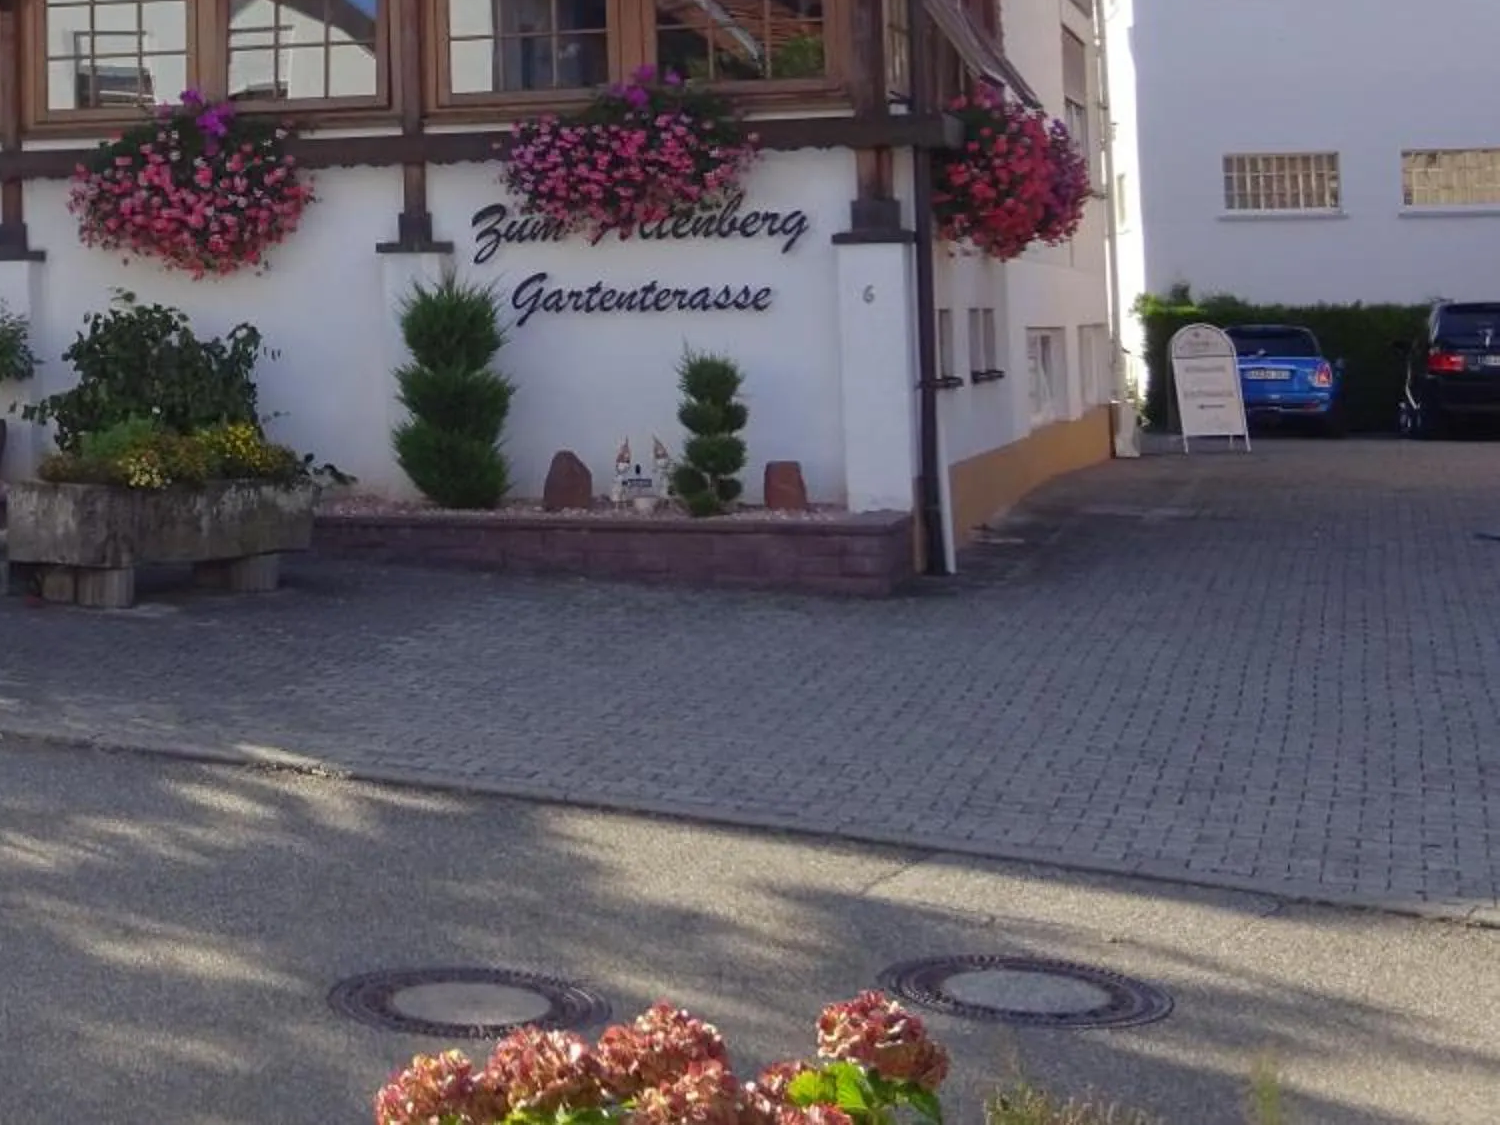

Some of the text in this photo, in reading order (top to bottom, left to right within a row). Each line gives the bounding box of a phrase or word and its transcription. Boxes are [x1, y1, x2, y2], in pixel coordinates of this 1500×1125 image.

[472, 203, 563, 264] Zum
[511, 272, 772, 327] Gartenterasse
[862, 284, 876, 305] 6
